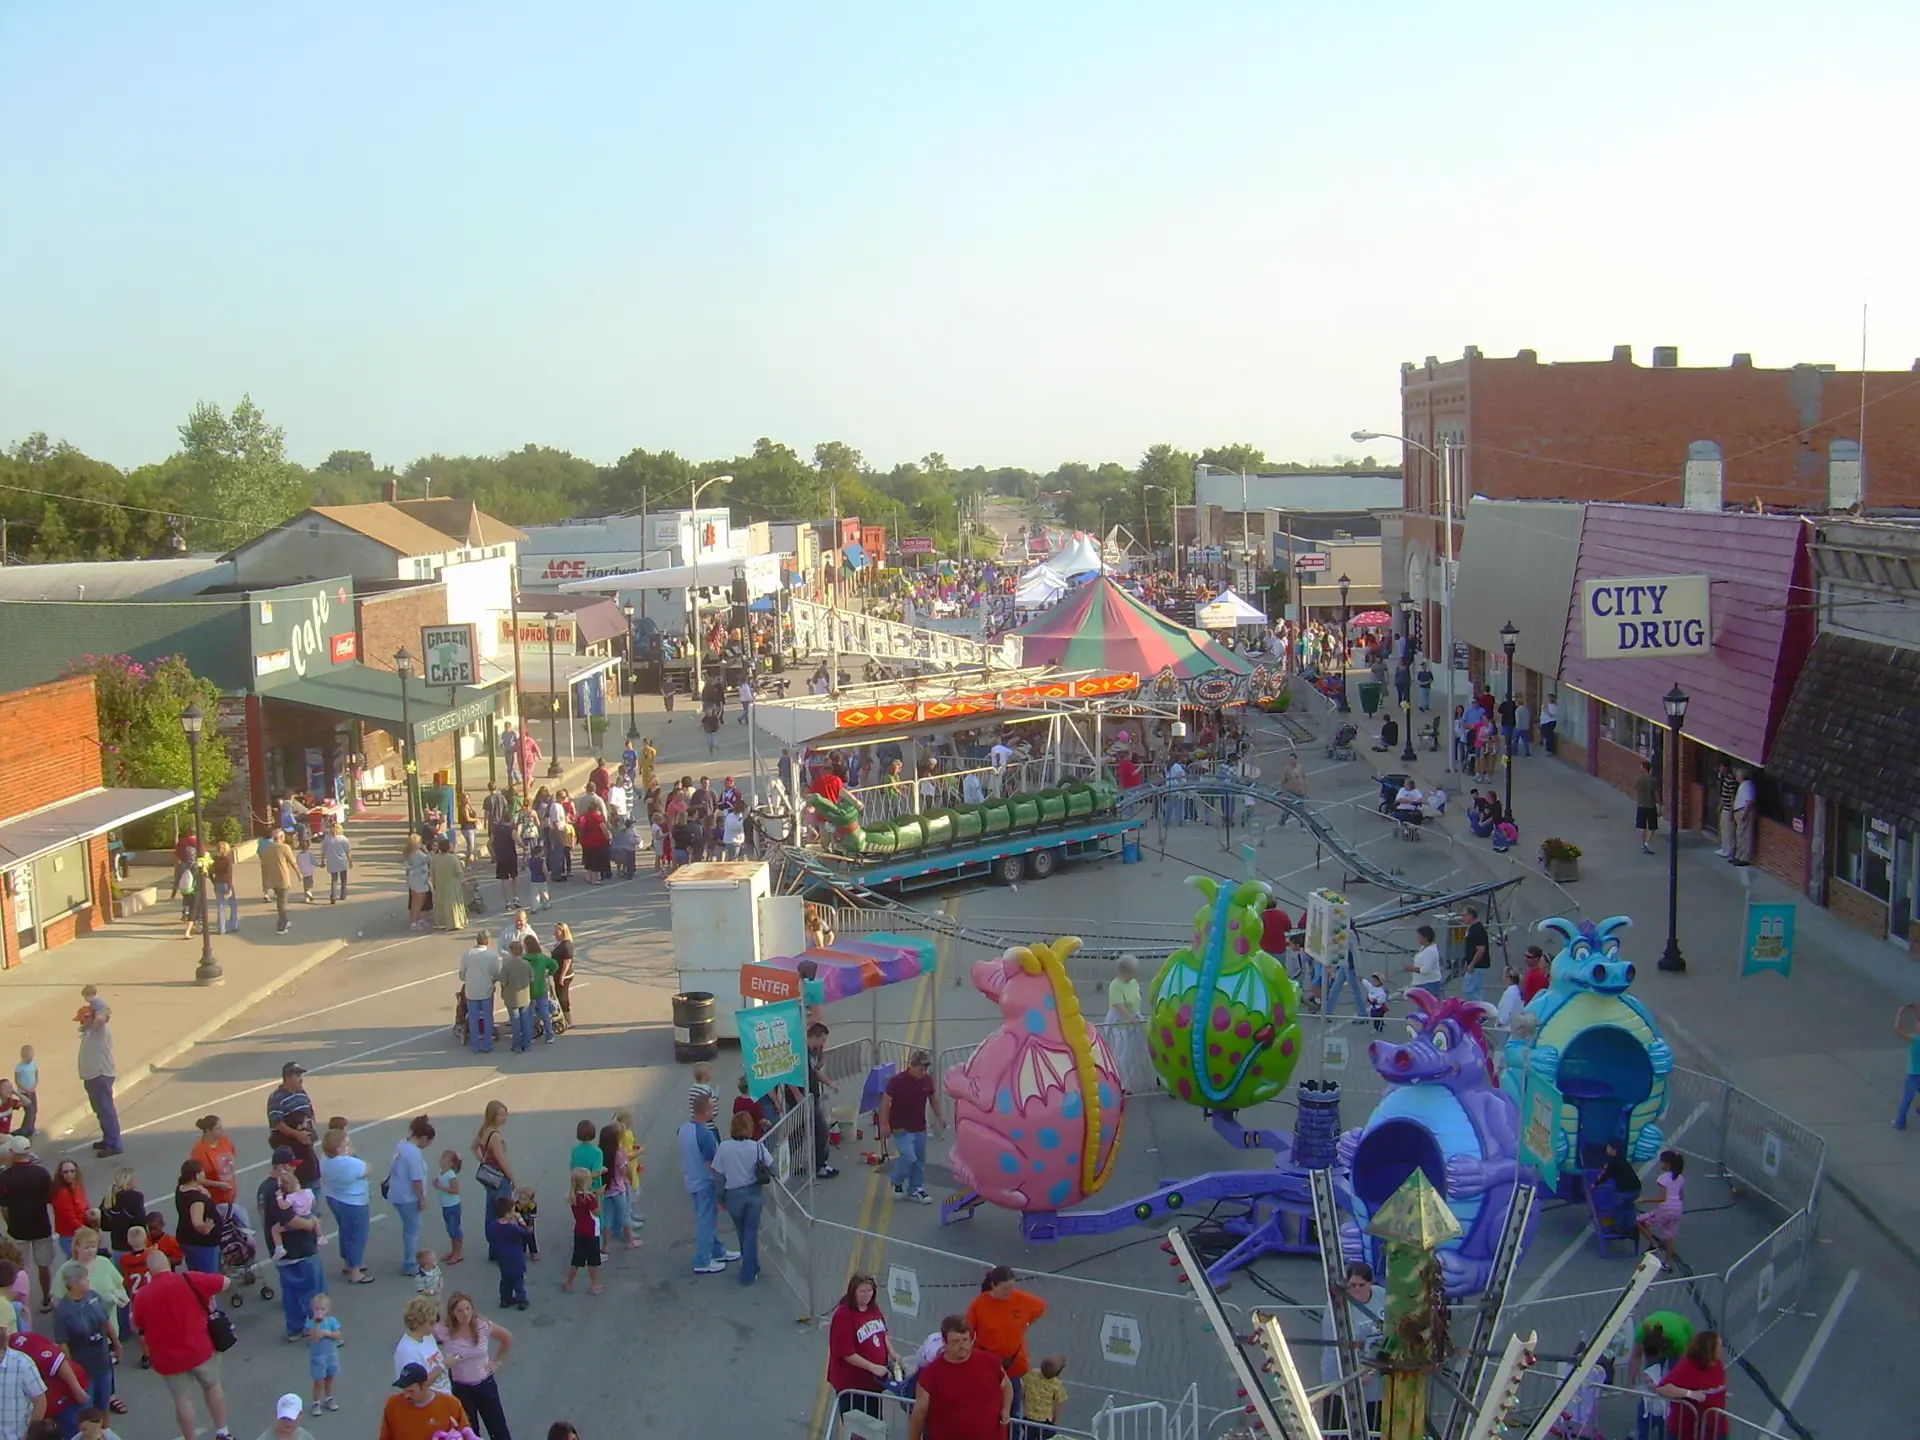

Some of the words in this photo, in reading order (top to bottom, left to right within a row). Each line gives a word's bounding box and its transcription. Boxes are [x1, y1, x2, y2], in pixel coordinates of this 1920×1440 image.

[541, 559, 585, 579] ACE
[1591, 585, 1668, 617] CITY
[292, 590, 329, 676] Cafe
[426, 630, 468, 649] GREEN
[519, 627, 571, 641] UPHOLERY
[1618, 618, 1705, 650] DRUG
[431, 662, 469, 682] CAFE
[421, 720, 437, 739] THE
[437, 709, 463, 732] GREEN
[462, 699, 488, 723] PARROT
[751, 976, 790, 996] ENTER
